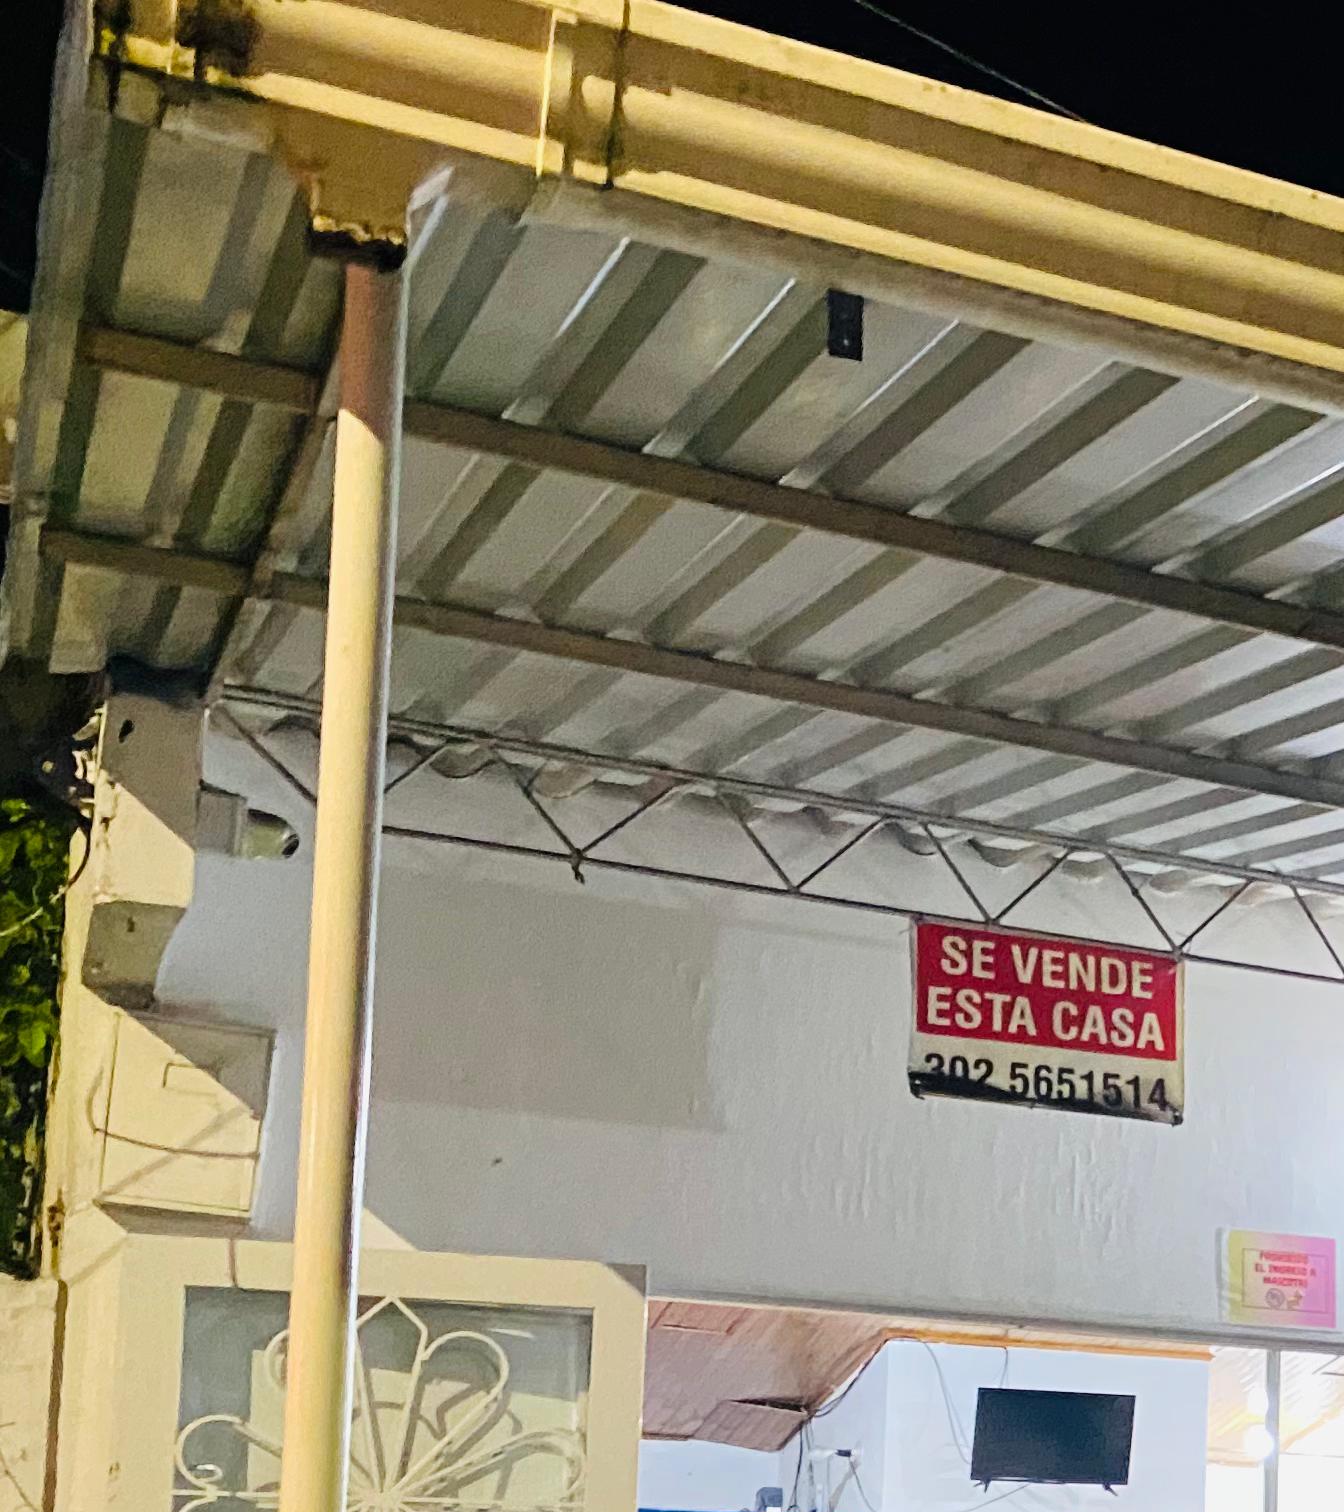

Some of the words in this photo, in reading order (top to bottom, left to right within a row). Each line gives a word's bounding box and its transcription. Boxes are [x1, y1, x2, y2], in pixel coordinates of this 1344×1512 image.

[940, 935, 996, 980] SE
[1011, 944, 1154, 999] VENDE
[926, 985, 1037, 1036] ESTA
[1052, 1001, 1165, 1052] CASA
[1009, 1062, 1170, 1112] 5651514
